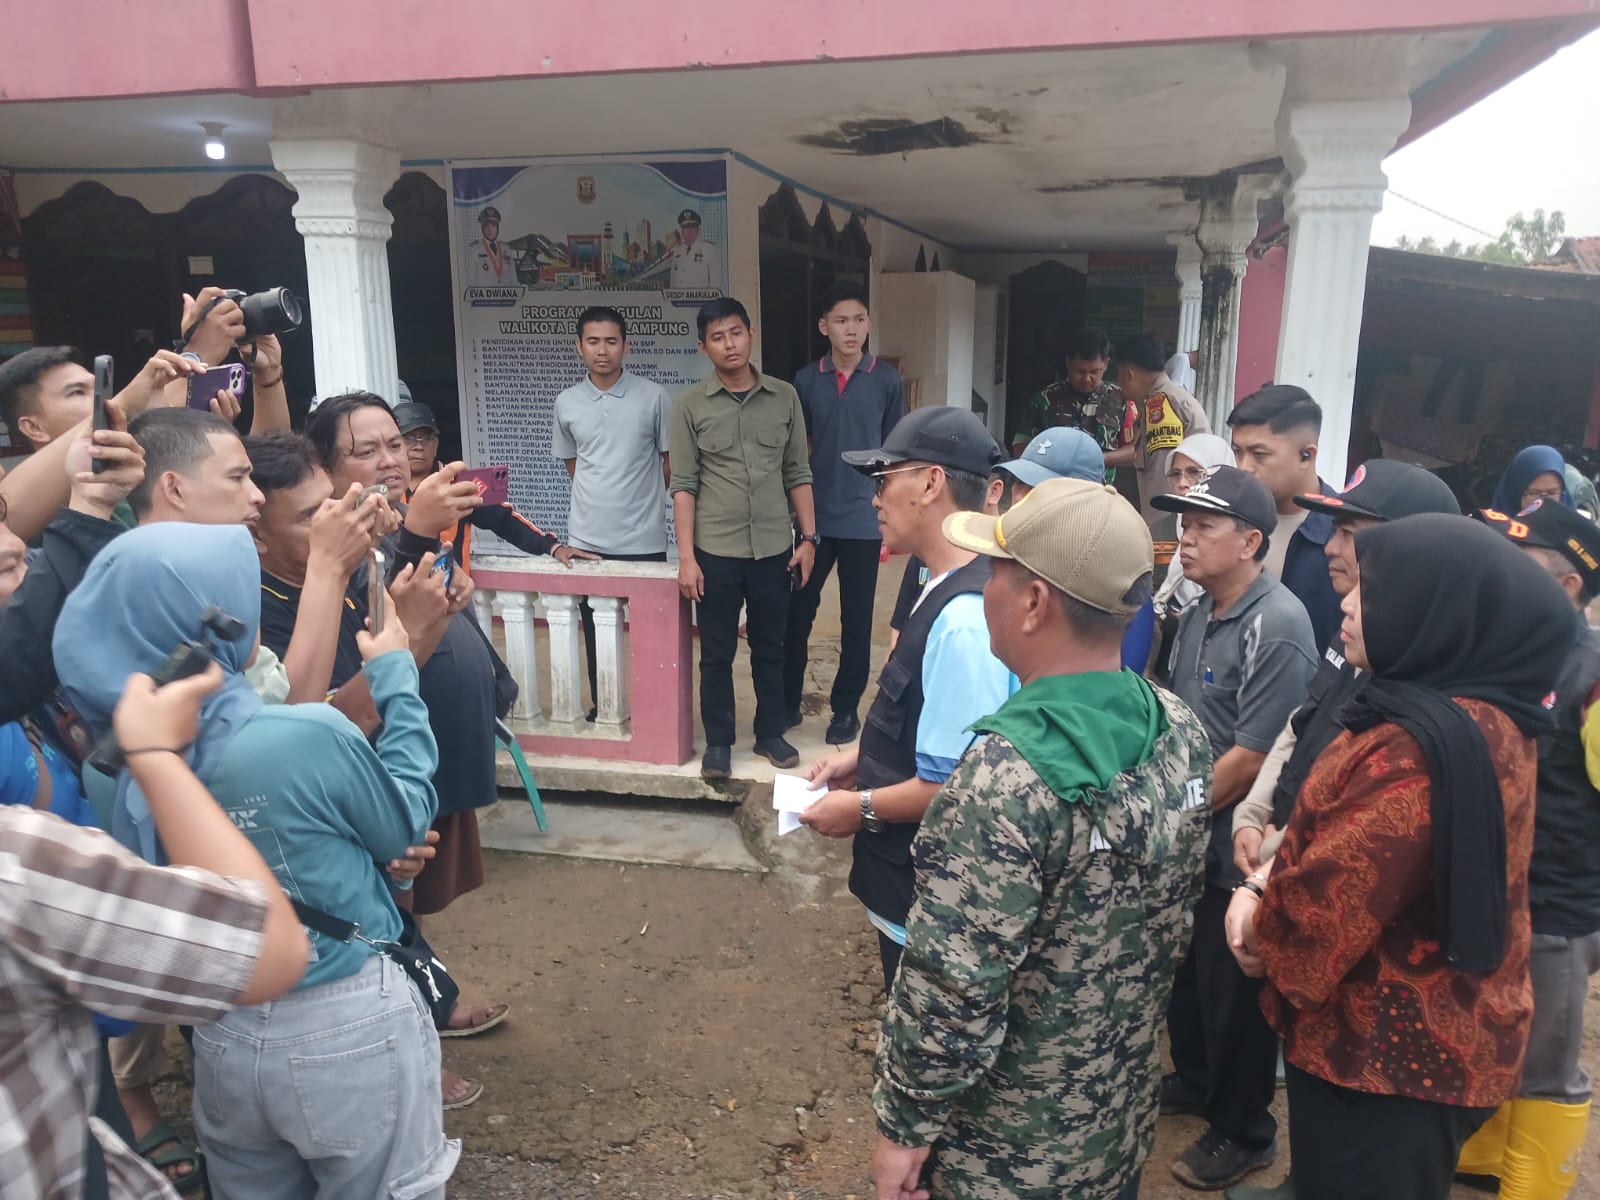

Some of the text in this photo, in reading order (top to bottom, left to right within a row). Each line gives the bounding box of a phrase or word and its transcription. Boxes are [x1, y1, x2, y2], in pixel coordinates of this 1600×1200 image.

[470, 289, 518, 298] EVA DWIANA
[499, 321, 567, 334] WALIKOTA
[626, 322, 689, 335] LAMPUNG
